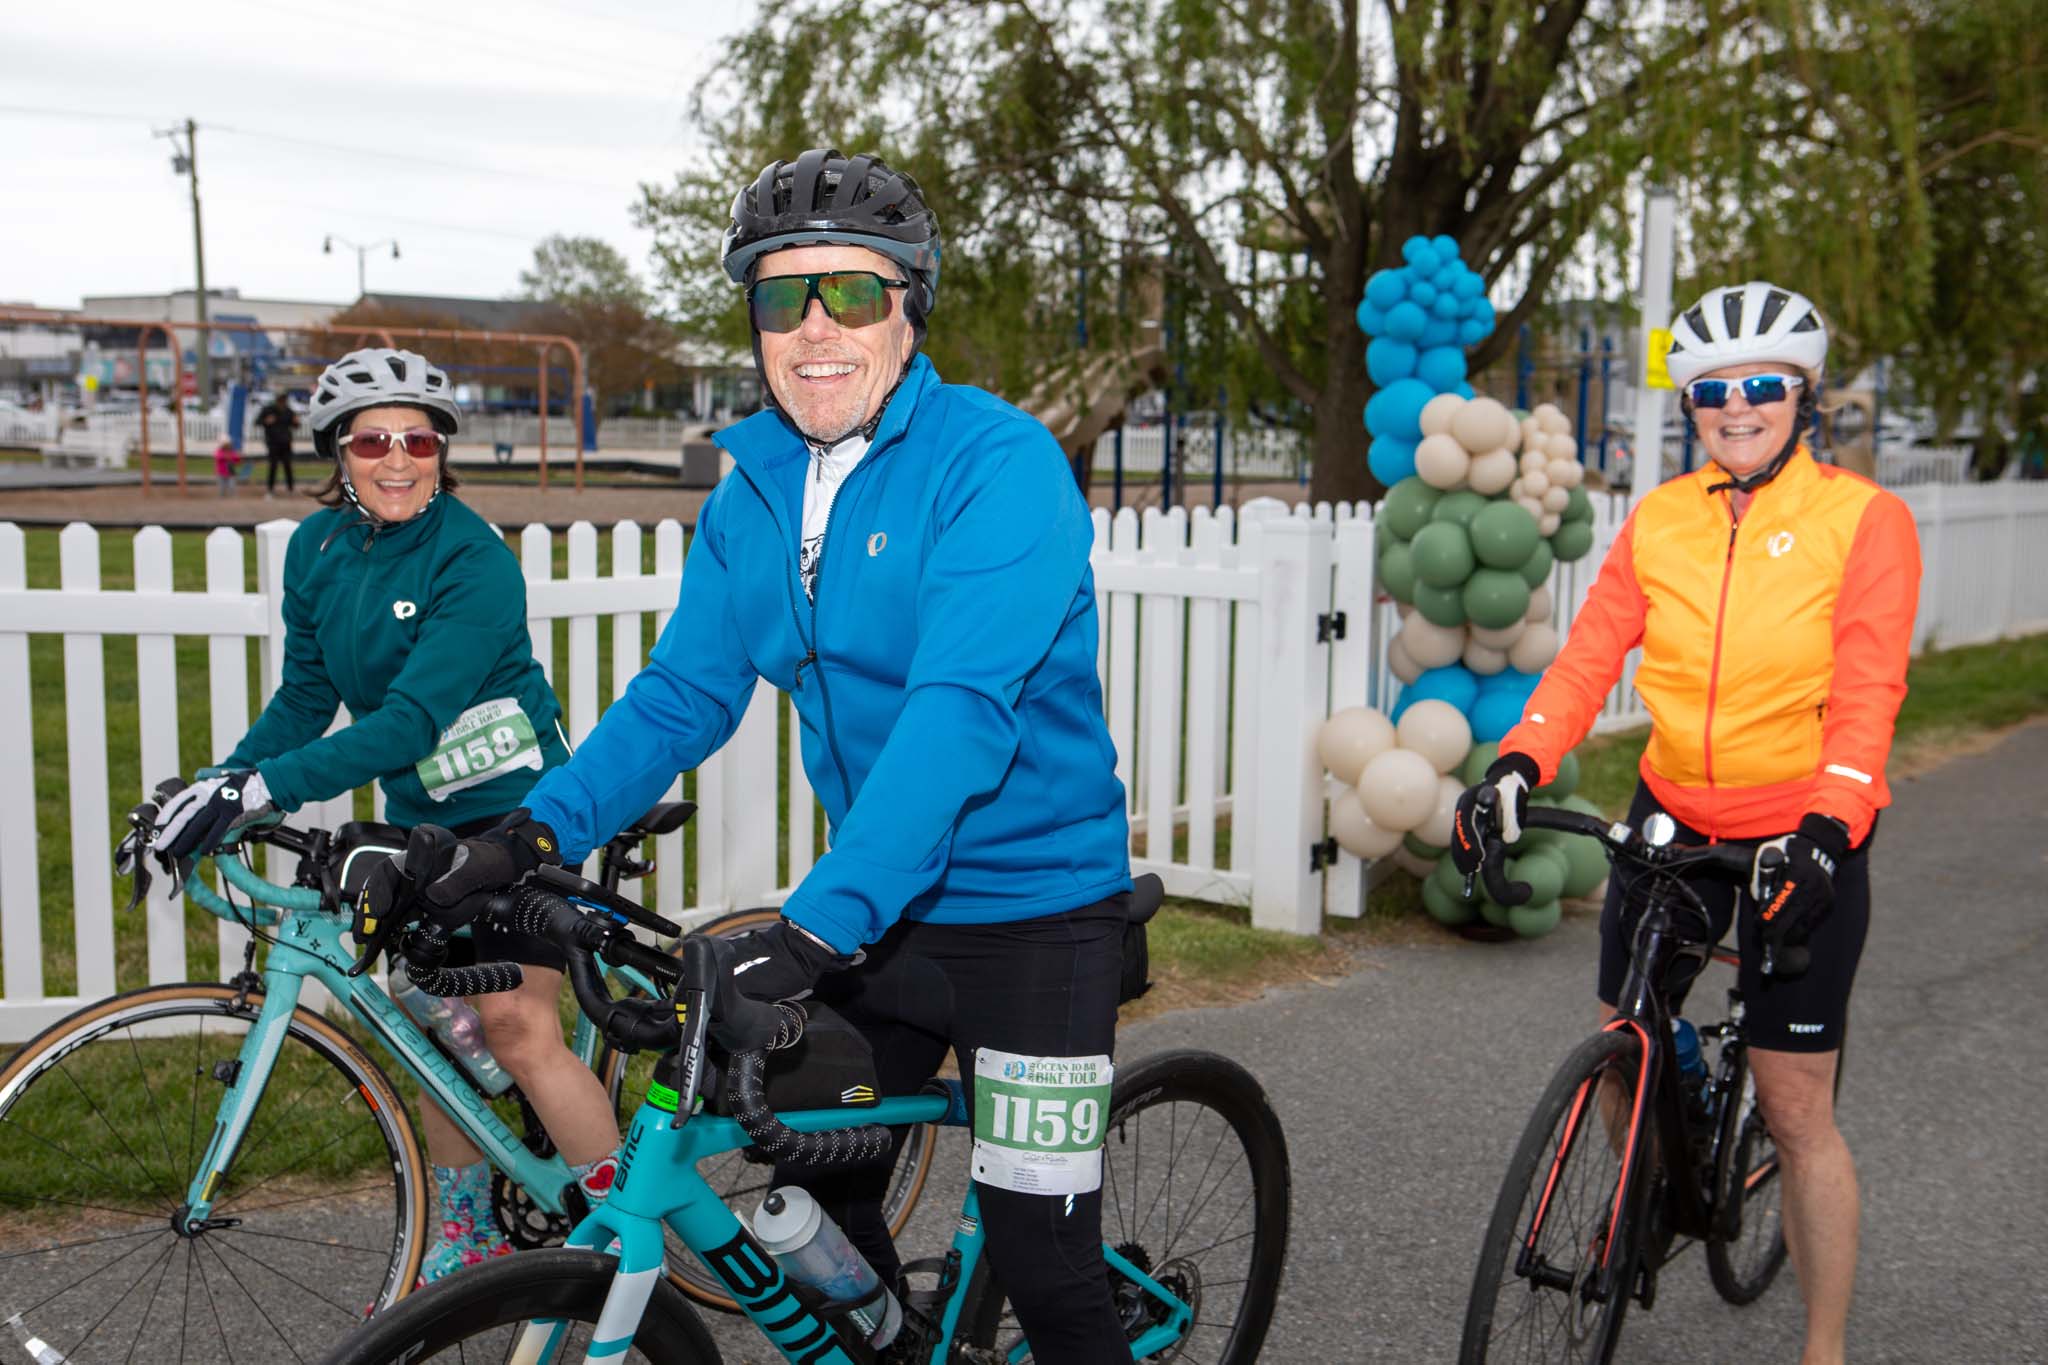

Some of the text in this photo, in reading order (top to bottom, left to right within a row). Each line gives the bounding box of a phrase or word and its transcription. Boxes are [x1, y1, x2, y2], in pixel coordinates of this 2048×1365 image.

[432, 726, 520, 782] 1158
[1035, 1072, 1097, 1085] BIKE TOUR
[1036, 1062, 1096, 1072] OCEAN TO BAY
[991, 1092, 1099, 1147] 1159
[613, 1119, 645, 1193] BMC
